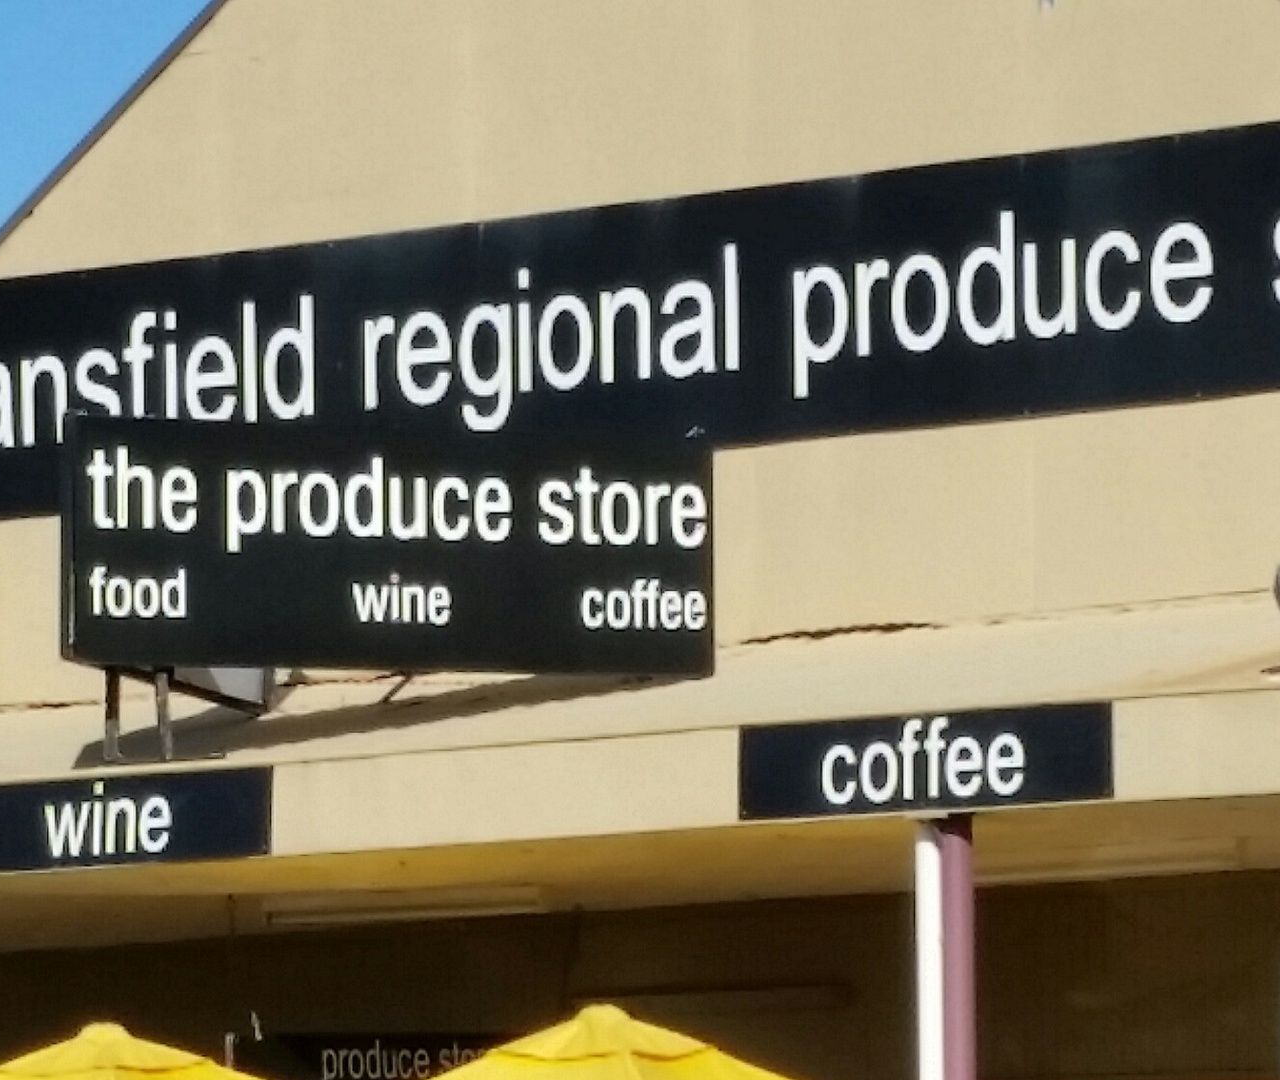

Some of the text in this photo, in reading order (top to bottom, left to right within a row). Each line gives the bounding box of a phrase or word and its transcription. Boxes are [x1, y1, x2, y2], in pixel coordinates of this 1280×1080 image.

[363, 242, 740, 433] regional
[792, 210, 1214, 398] produce
[85, 445, 707, 553] the produce store
[88, 565, 707, 631] food wine coffee
[821, 716, 1027, 805] coffee
[43, 780, 173, 858] wine
